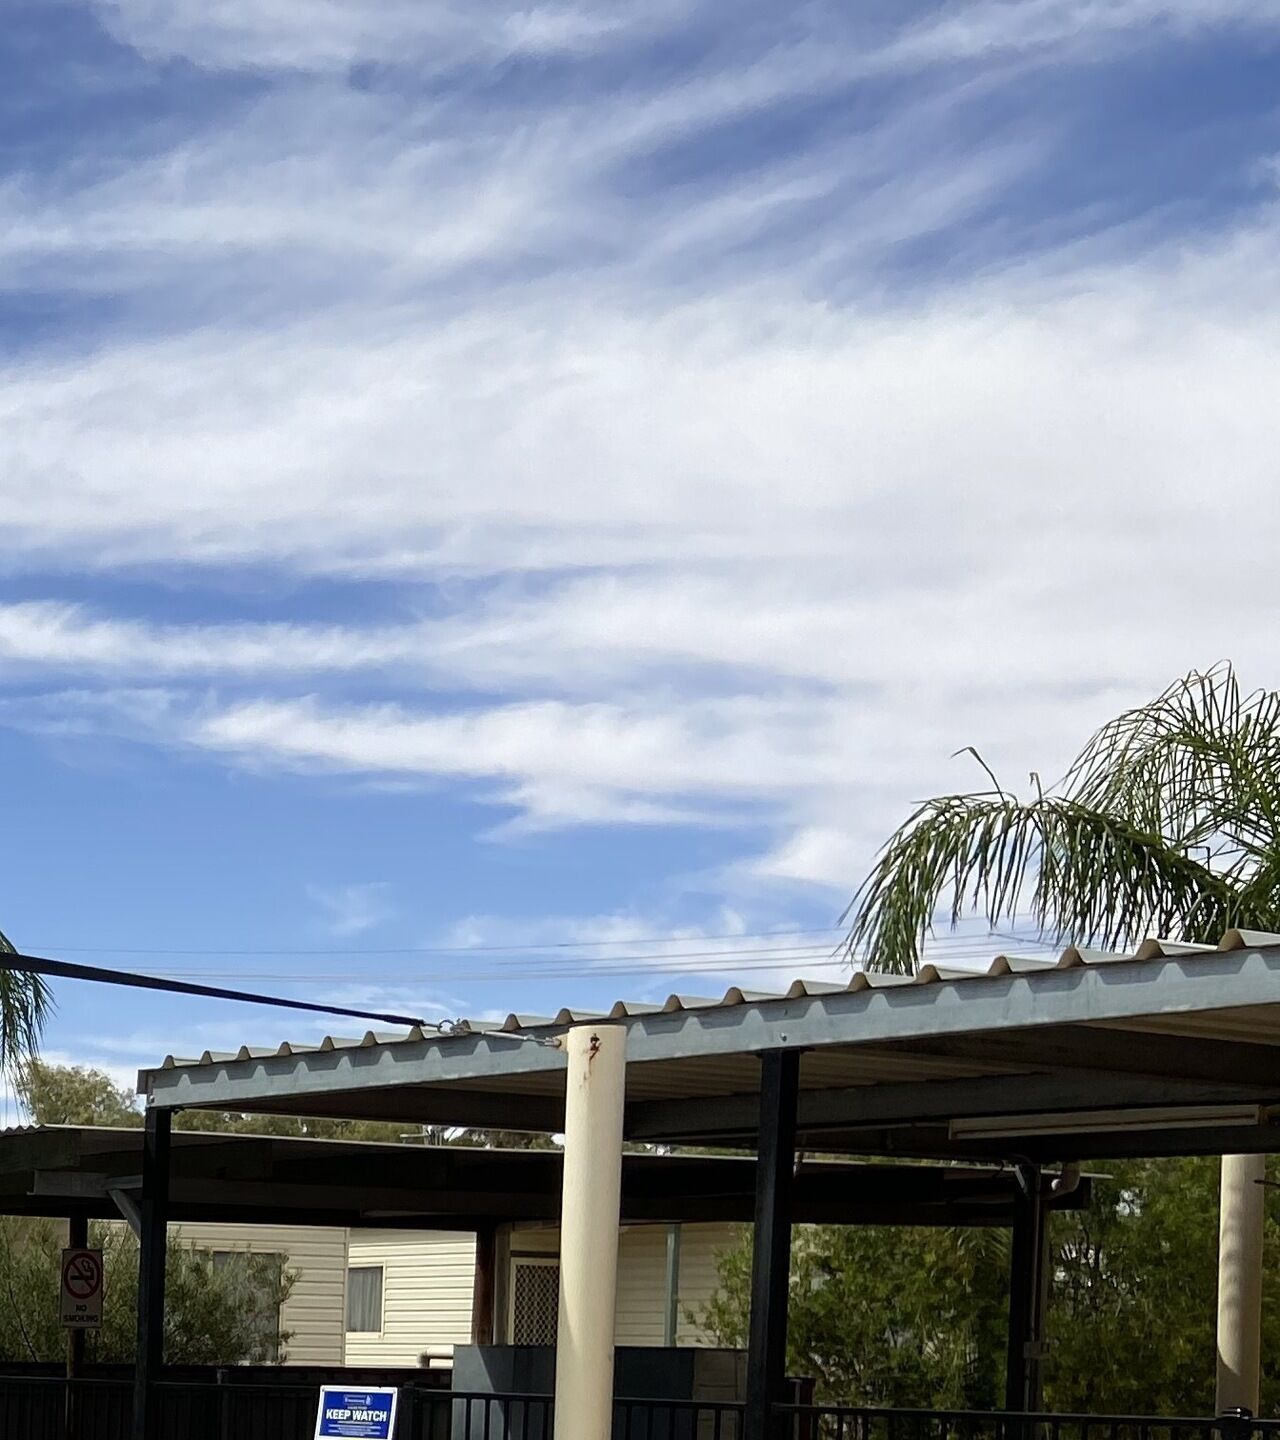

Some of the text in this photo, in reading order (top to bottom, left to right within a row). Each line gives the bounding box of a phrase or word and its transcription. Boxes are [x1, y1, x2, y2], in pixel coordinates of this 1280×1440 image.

[75, 1304, 87, 1312] NO
[326, 1408, 387, 1422] KEEP WATCH
